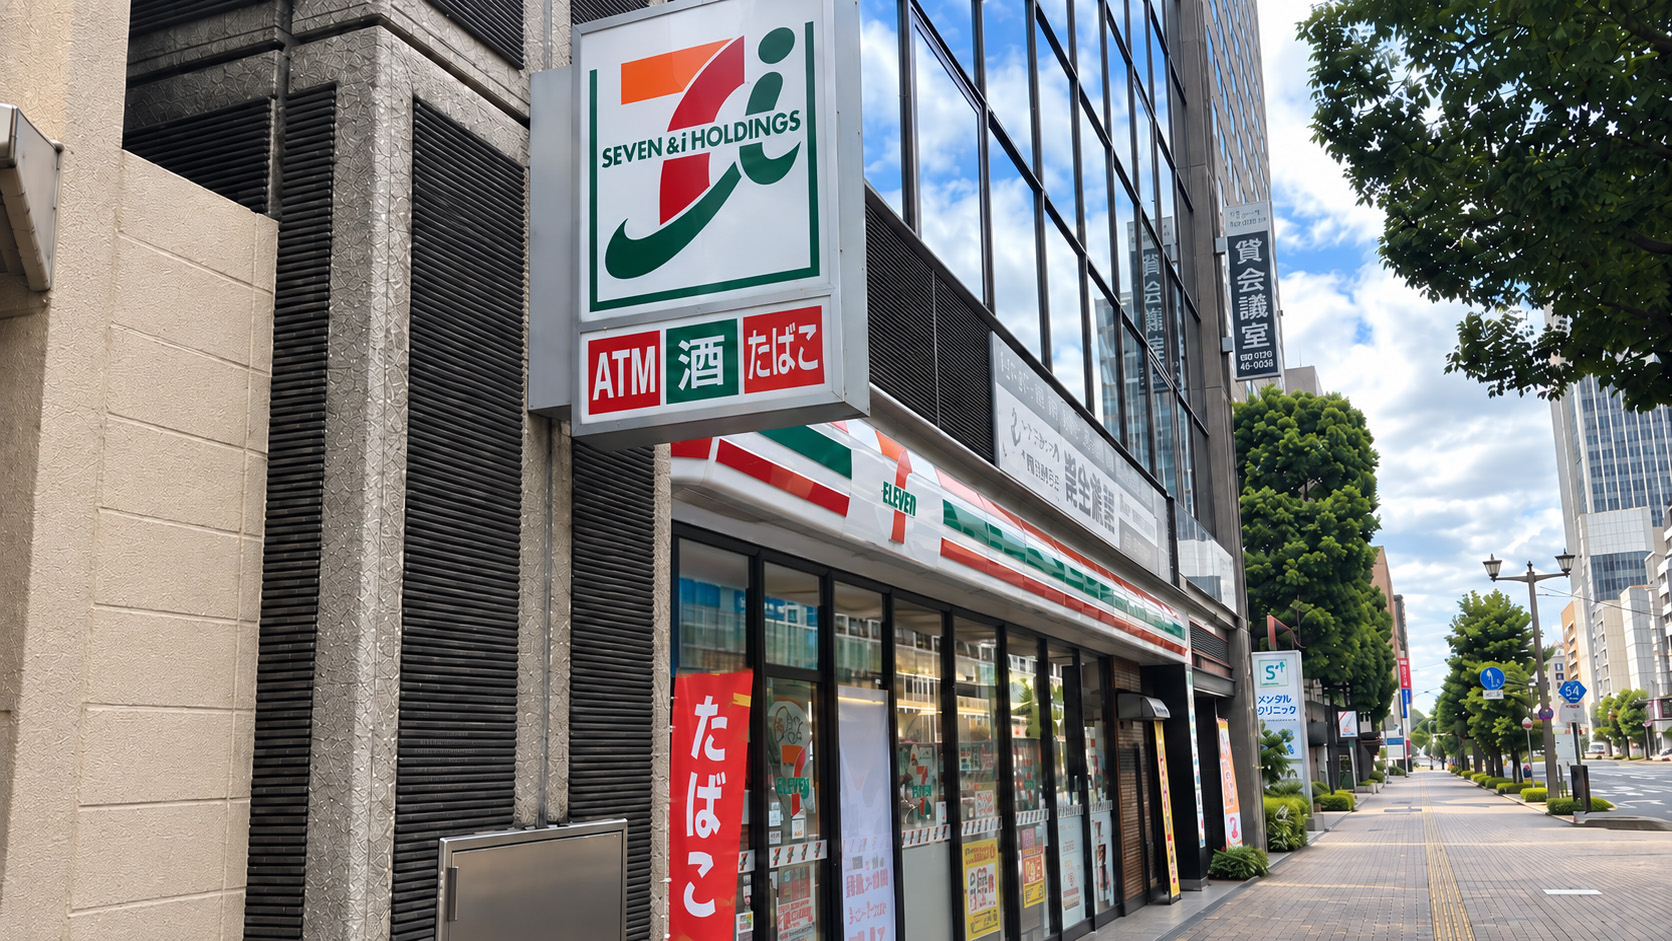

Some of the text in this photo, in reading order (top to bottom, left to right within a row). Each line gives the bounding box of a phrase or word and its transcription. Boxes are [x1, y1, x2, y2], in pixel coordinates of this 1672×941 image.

[602, 137, 663, 168] SEVEN
[691, 109, 801, 150] HOLDINGS
[592, 345, 656, 401] ATM
[677, 334, 725, 391] 酒
[748, 322, 819, 380] たばこ
[1257, 705, 1296, 715] クリニック
[1258, 694, 1292, 704] メンタル
[684, 695, 728, 918] たばこ
